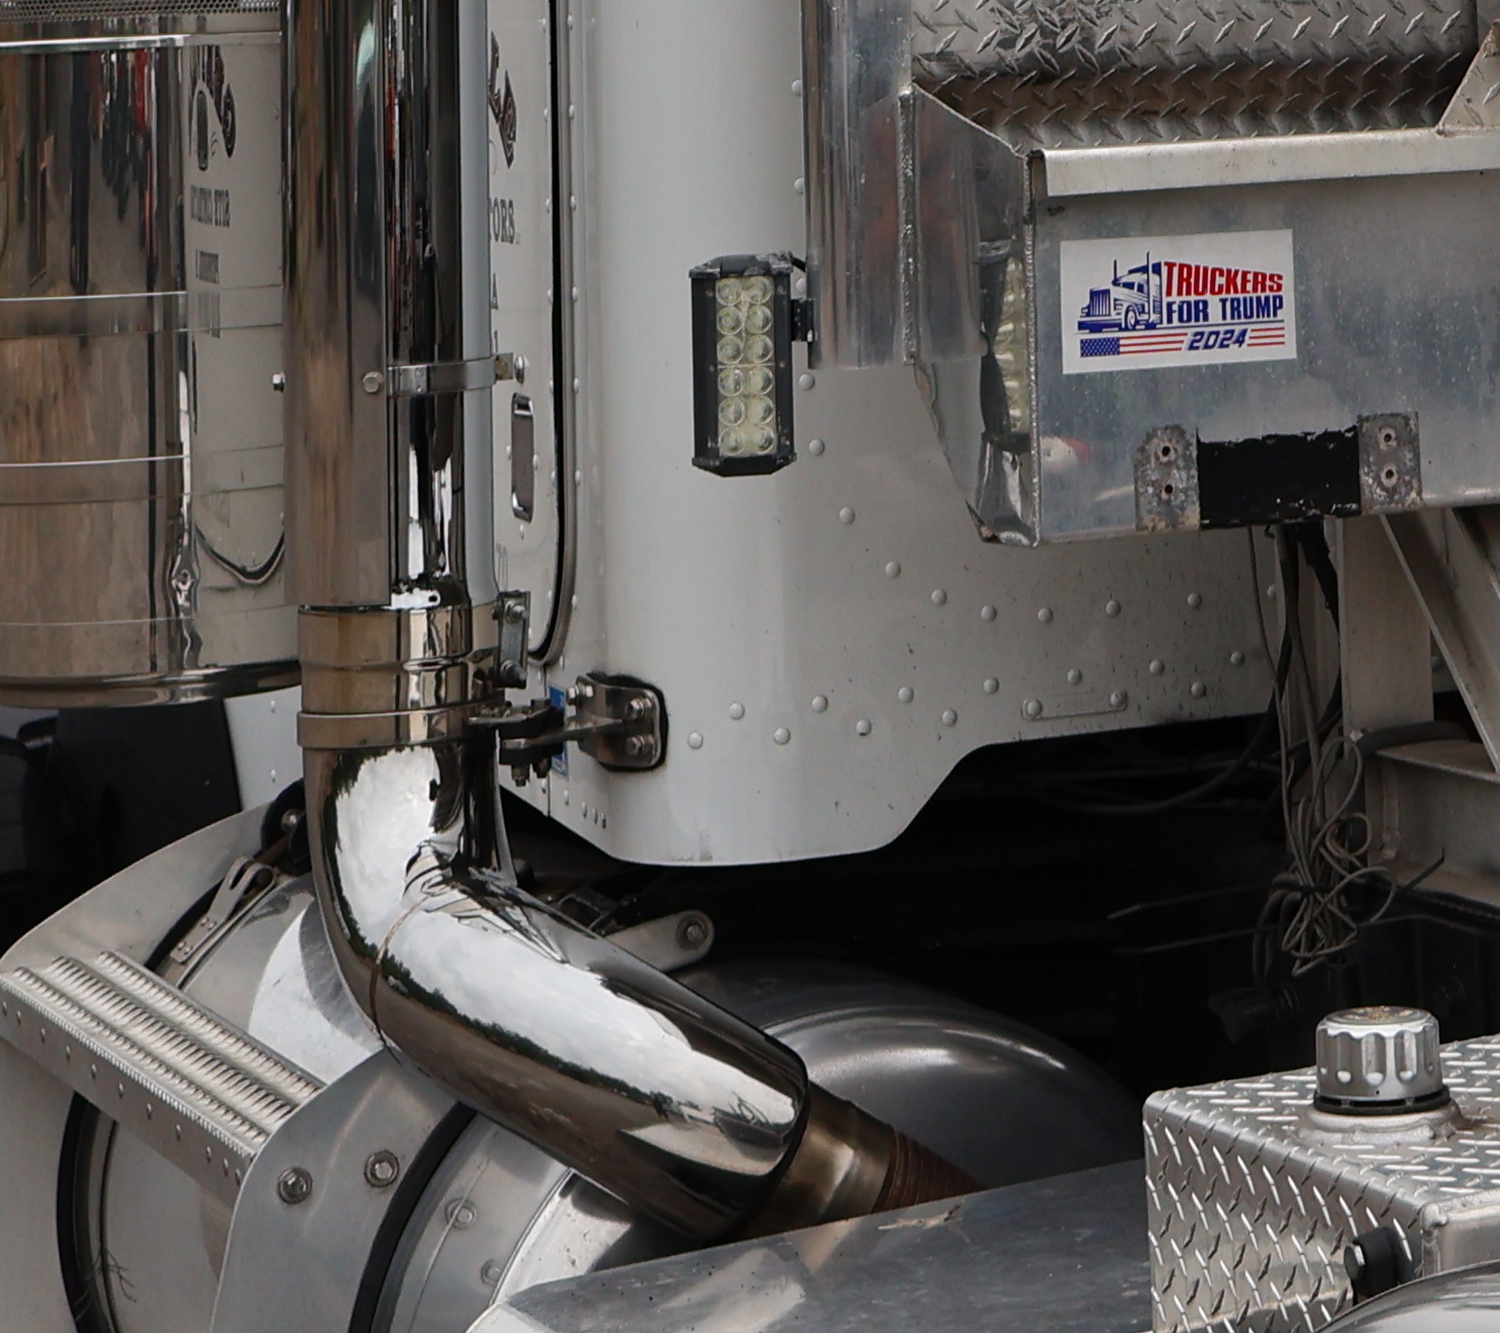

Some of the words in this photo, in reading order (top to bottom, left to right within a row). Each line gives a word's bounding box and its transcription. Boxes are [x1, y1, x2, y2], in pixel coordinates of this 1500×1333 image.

[1164, 261, 1284, 298] TRUCKERS
[1166, 300, 1209, 325] FOR
[1219, 295, 1284, 321] TRUMP
[1187, 327, 1249, 352] 2024
